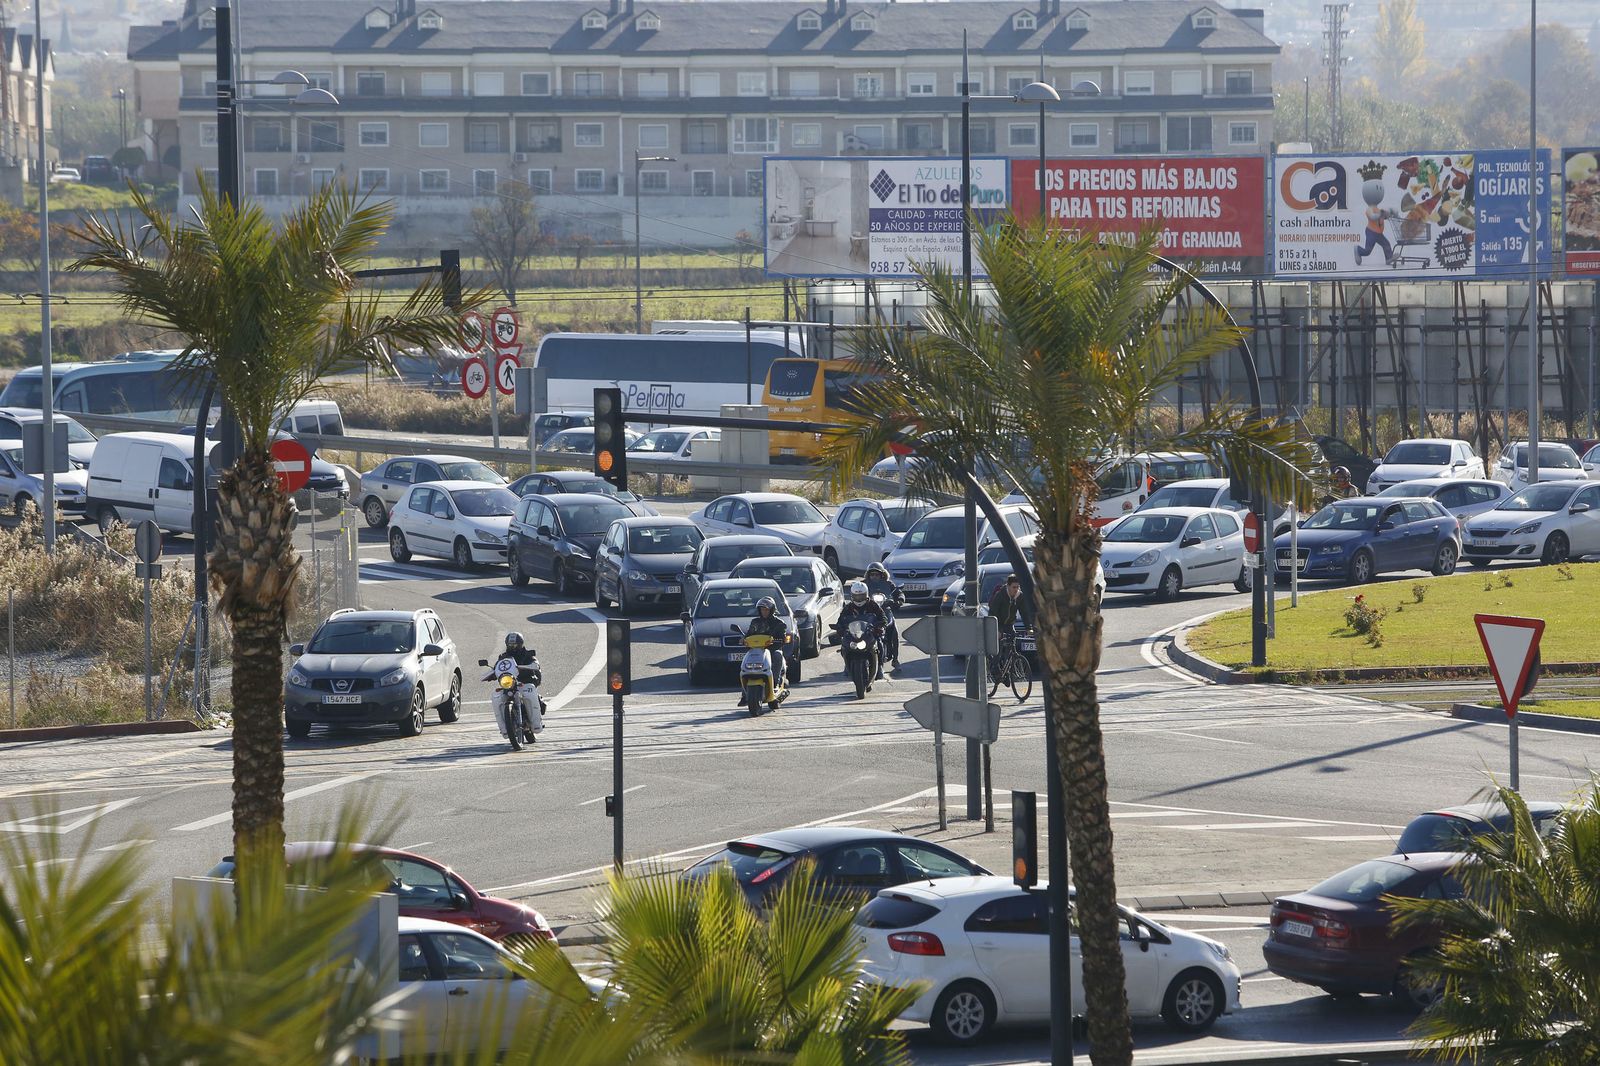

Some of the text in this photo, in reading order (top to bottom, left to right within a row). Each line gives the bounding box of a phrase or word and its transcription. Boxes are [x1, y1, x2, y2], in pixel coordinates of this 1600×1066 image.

[1479, 163, 1495, 172] POL.
[1035, 163, 1238, 191] LOS PRECIOS MÁS BAJOS
[898, 184, 911, 203] El
[970, 184, 1004, 204] Puro
[1051, 196, 1221, 218] PARA TUS REFORMAS
[888, 210, 926, 219] CALIDAD
[1480, 210, 1500, 223] 5 min
[871, 222, 881, 231] 50
[885, 220, 911, 231] AÑOS
[914, 222, 924, 231] DE
[1280, 216, 1351, 228] cash alhambra
[1182, 231, 1242, 248] GRANADA
[1279, 234, 1307, 242] HORARIO
[1441, 236, 1463, 246] ABIERTO
[1481, 236, 1522, 250] Salida 135
[1280, 249, 1294, 259] 8'15
[1302, 249, 1310, 258] 21
[1445, 245, 1458, 255] TODO
[1460, 243, 1466, 251] EL
[1482, 254, 1497, 263] A-44
[871, 262, 889, 273] 958
[893, 262, 905, 273] 57
[1221, 261, 1242, 272] A-44
[1280, 261, 1301, 271] LUNES
[628, 384, 686, 408] Periana
